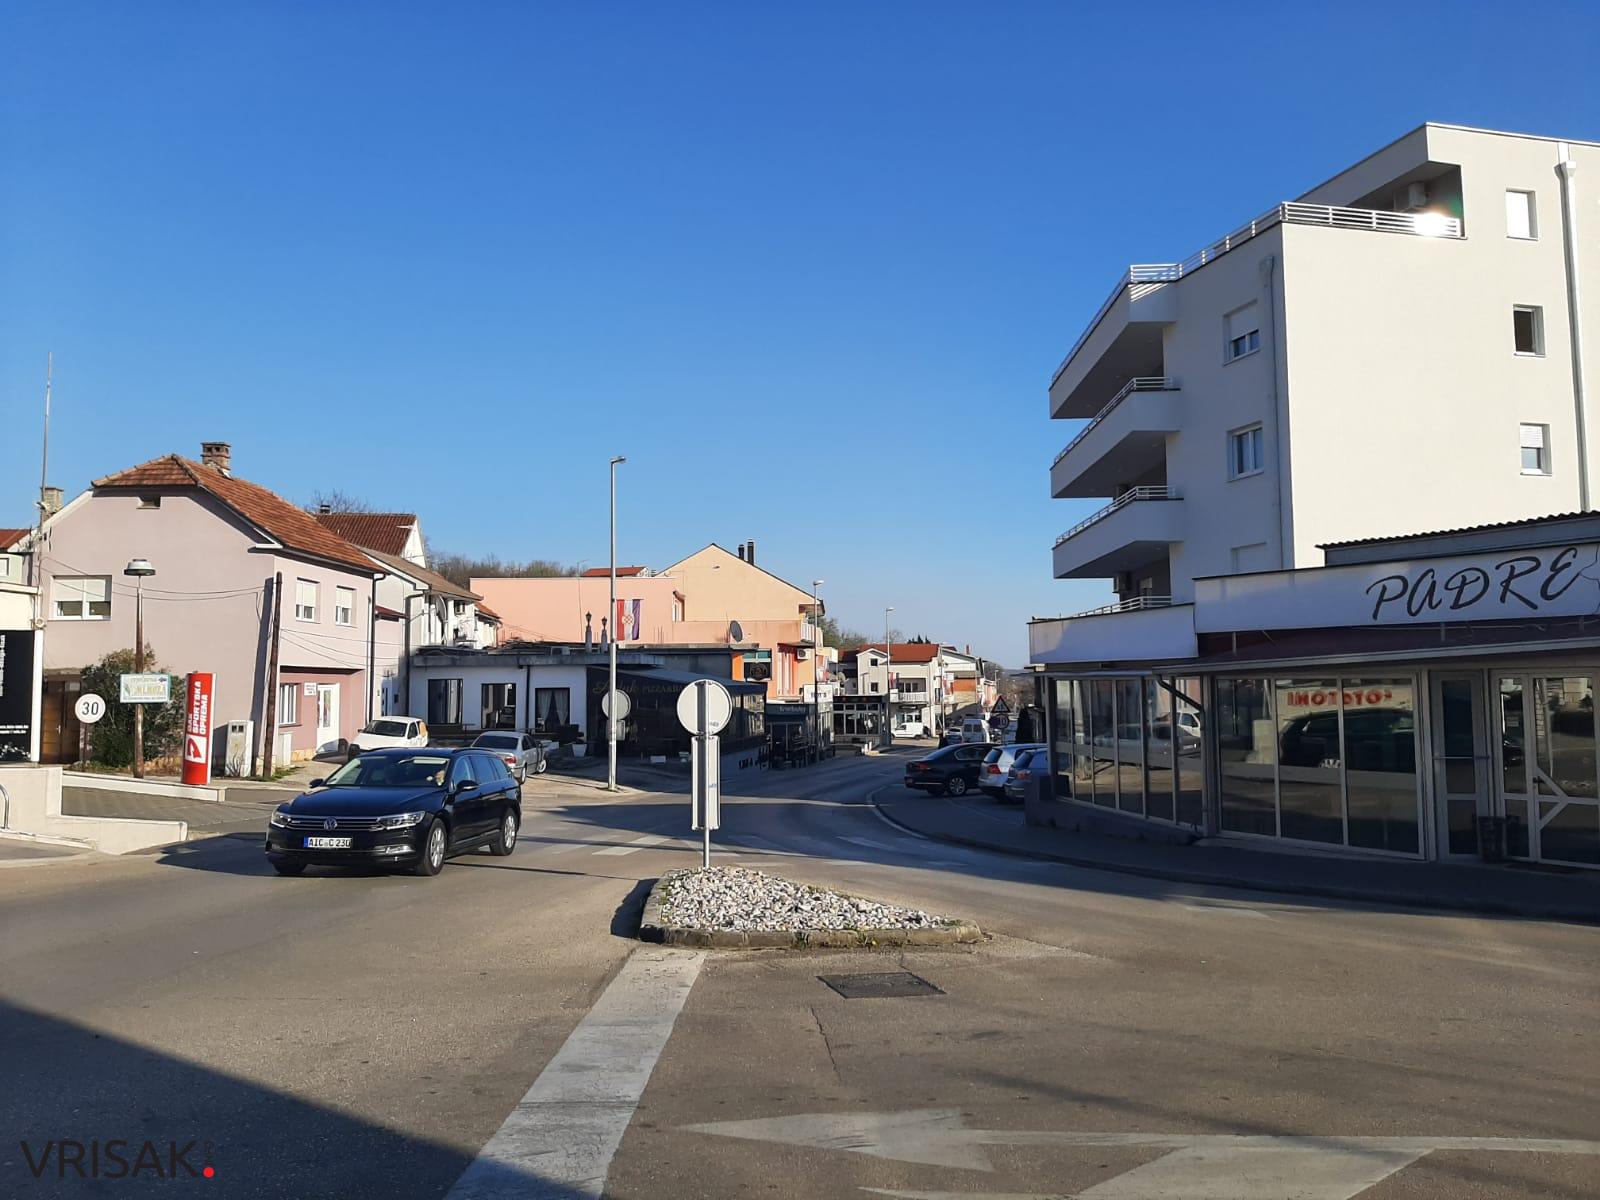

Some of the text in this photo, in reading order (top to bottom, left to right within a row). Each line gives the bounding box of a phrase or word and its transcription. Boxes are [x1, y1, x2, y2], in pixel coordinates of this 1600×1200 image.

[82, 701, 99, 716] 30
[192, 681, 202, 734] SPORTSKA
[199, 694, 209, 735] OPREMA
